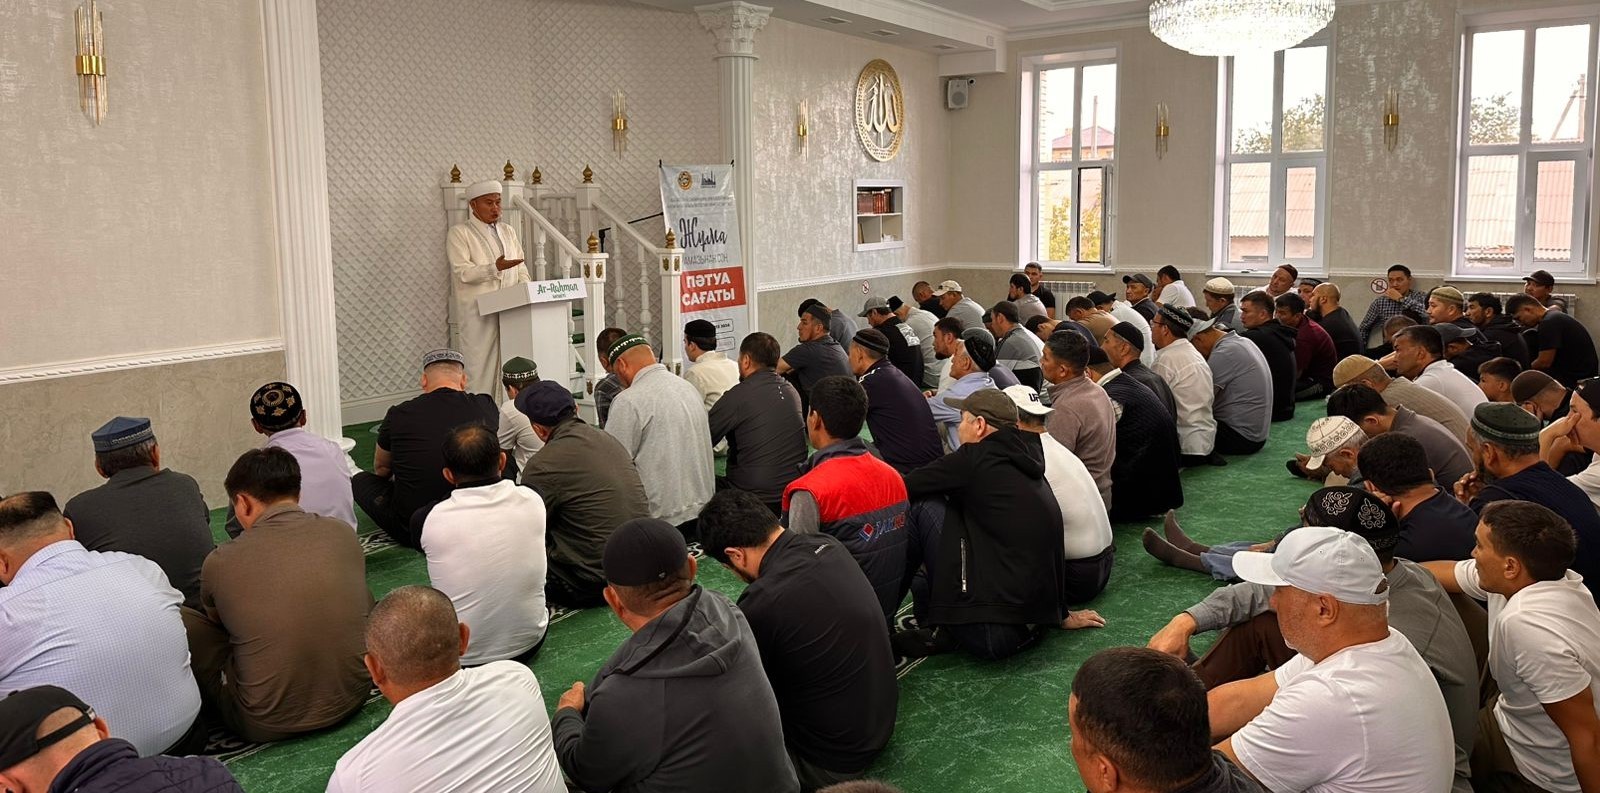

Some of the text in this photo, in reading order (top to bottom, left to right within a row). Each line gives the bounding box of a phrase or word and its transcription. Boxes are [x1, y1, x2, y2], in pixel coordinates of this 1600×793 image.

[683, 254, 717, 265] АМАЗЫНАН
[686, 272, 731, 288] ПӘТУА
[681, 288, 735, 306] САҒАТЫ
[1028, 393, 1040, 402] UF
